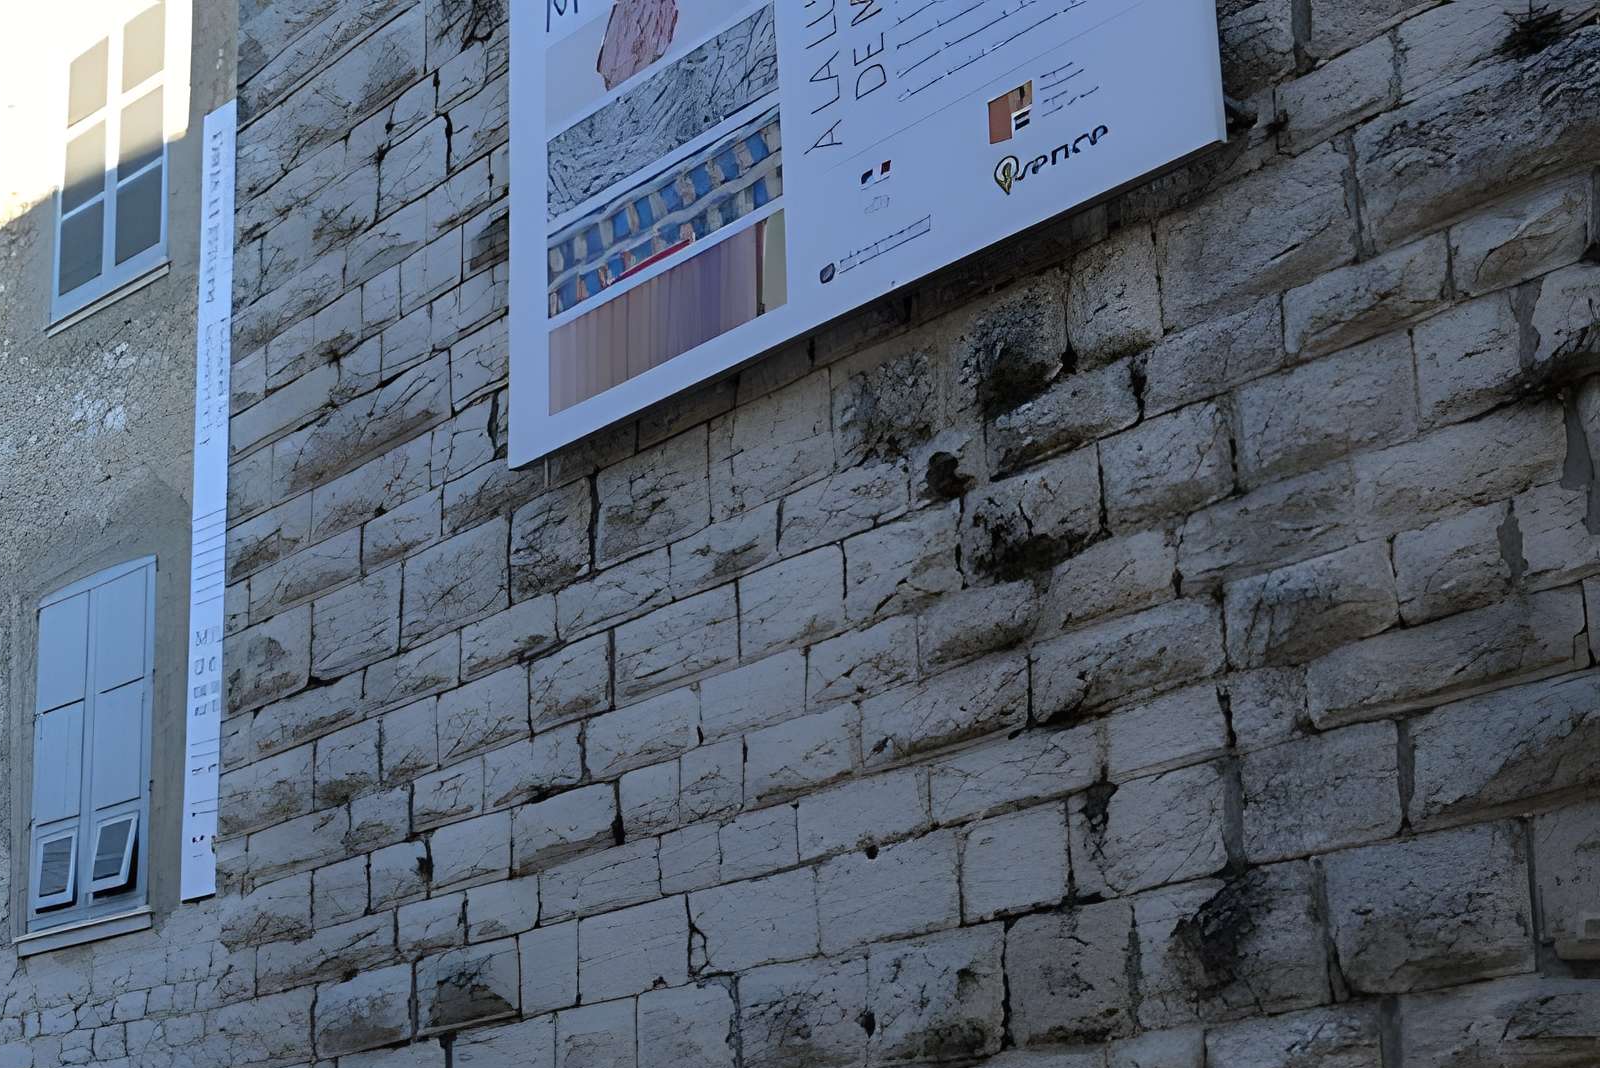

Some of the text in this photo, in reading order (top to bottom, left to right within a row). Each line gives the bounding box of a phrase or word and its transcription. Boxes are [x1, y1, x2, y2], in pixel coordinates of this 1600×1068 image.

[809, 50, 841, 115] LA
[852, 31, 888, 101] DE
[802, 118, 844, 156] A
